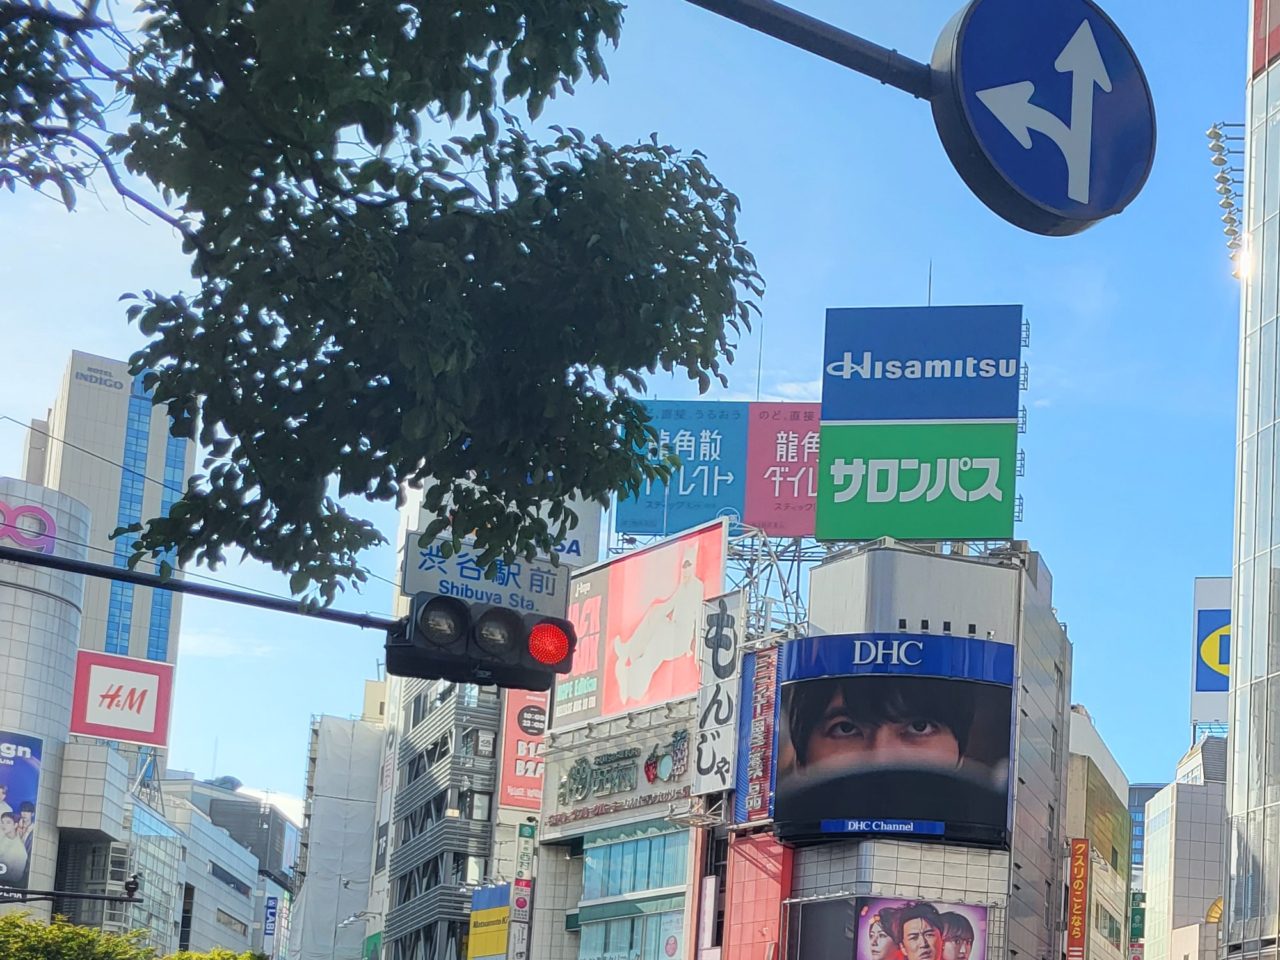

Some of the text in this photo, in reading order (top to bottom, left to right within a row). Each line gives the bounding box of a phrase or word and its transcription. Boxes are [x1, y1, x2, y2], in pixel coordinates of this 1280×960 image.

[87, 366, 114, 378] HOTEL
[826, 351, 1017, 380] Hisamitsu
[75, 371, 124, 390] INDIGO
[830, 456, 1003, 504] サロンパス
[439, 579, 540, 612] Shibuya Sta.
[852, 640, 923, 667] DHC
[98, 683, 148, 715] H&M
[696, 599, 738, 787] もんじゃ
[847, 820, 914, 832] DHC Channel
[1071, 843, 1086, 940] クスリのことなら
[264, 908, 277, 934] LABI
